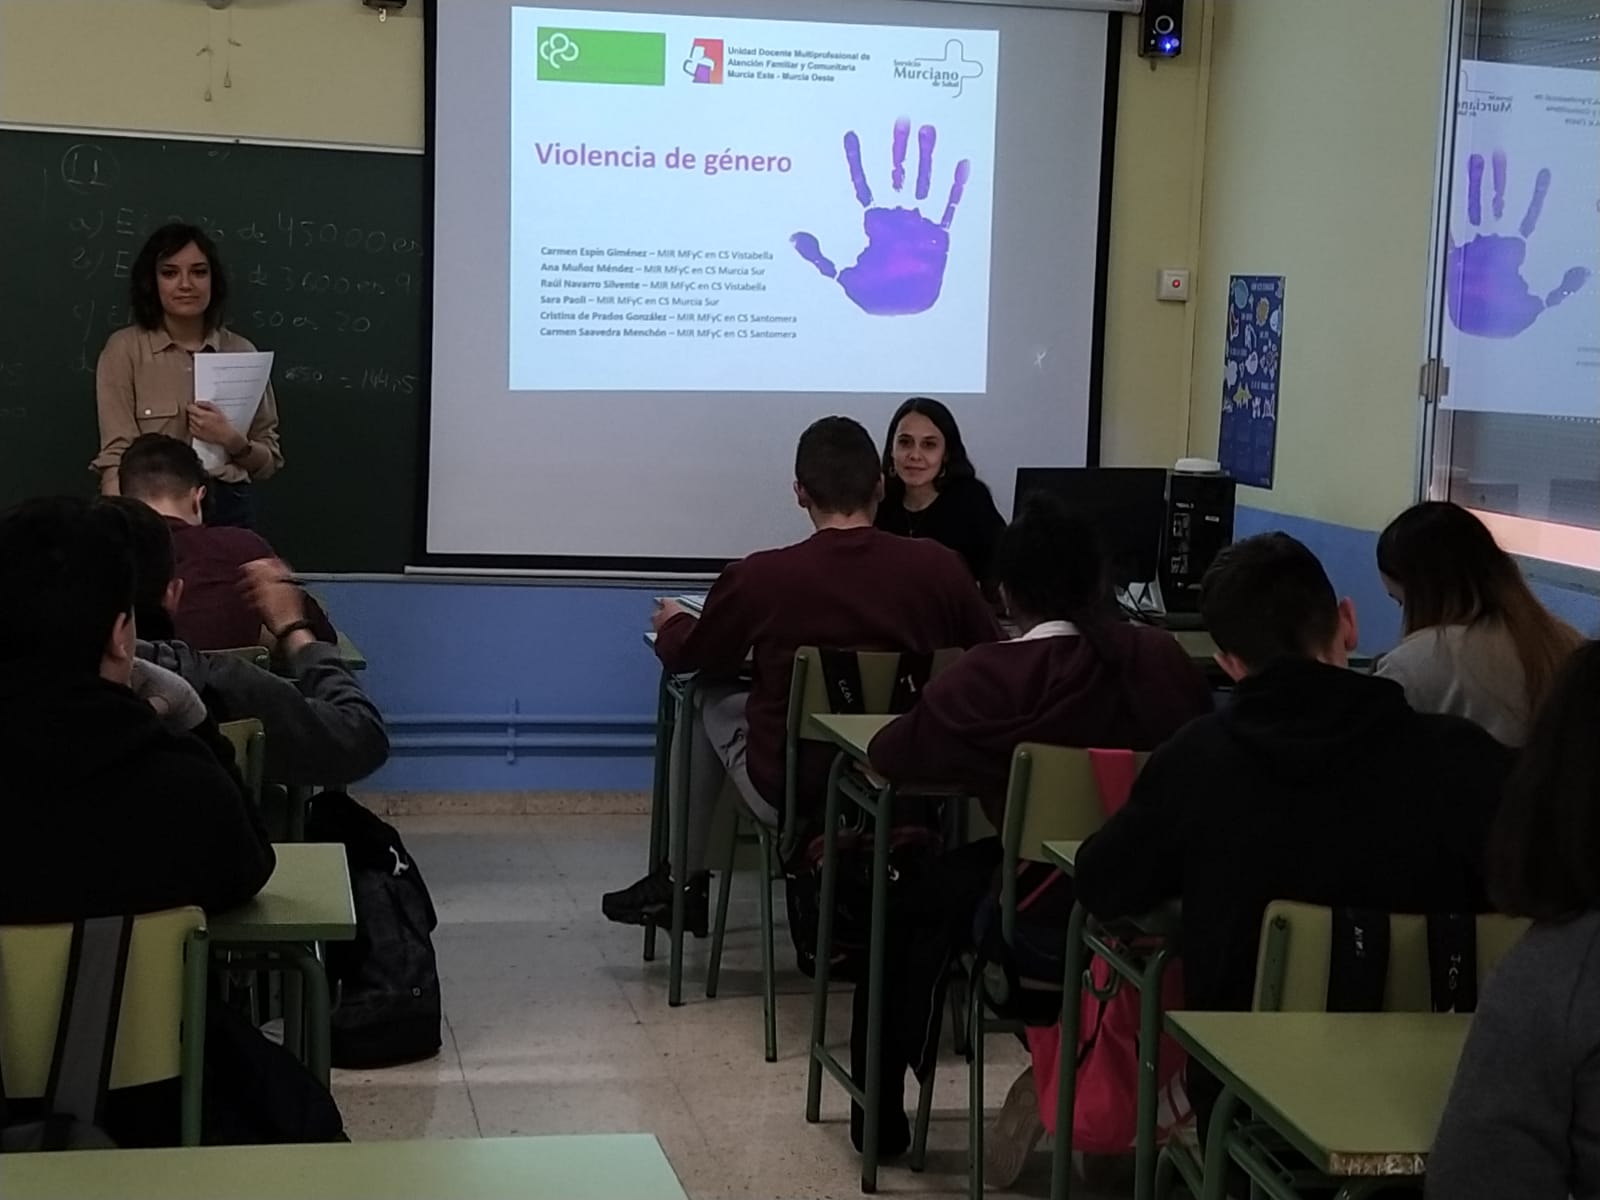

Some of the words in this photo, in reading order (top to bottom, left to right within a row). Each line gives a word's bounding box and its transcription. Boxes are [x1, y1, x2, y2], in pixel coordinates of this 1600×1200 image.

[727, 46, 757, 56] Unidad
[758, 48, 792, 57] Docente
[793, 50, 859, 60] Multiprofesional
[860, 53, 871, 61] de
[727, 58, 764, 68] Atención
[766, 60, 799, 69] Familiar
[807, 61, 856, 71] Comunitaria
[727, 69, 755, 78] Murcia
[756, 71, 775, 79] Este
[781, 72, 809, 81] Murcia
[811, 73, 835, 82] Oeste
[893, 66, 960, 81] Murciano
[534, 141, 657, 168] Violencia
[664, 146, 697, 170] de
[703, 147, 793, 176] género
[540, 246, 578, 256] Carmen
[606, 248, 648, 258] Giménez
[657, 249, 676, 258] MIR
[677, 249, 703, 260] MFyC
[718, 250, 730, 260] CS
[731, 251, 774, 260] Vistabella
[540, 263, 560, 272] Ana
[561, 263, 594, 272] Muñoz
[596, 264, 634, 273] Méndez
[643, 265, 662, 274] MIR
[664, 265, 690, 276] MFyC
[705, 266, 717, 275] CS
[718, 266, 749, 276] Murcia
[751, 267, 766, 276] Sur
[540, 279, 562, 288] Raúl
[563, 280, 602, 289] Navarro
[603, 280, 640, 289] Silvente
[650, 281, 668, 290] MIR
[670, 281, 696, 292] MFyC
[711, 282, 723, 291] CS
[724, 282, 767, 292] Vistabella
[540, 295, 561, 304] Sara
[596, 296, 615, 305] MIR
[617, 296, 643, 307] MFyC
[658, 297, 670, 306] CS
[672, 297, 703, 306] Murcia
[705, 298, 720, 306] Sur
[540, 311, 576, 321] Cristina
[577, 311, 590, 321] de
[591, 312, 624, 321] Prados
[625, 312, 667, 321] González
[676, 313, 695, 322] MIR
[696, 313, 722, 324] MFyC
[737, 314, 749, 323] CS
[750, 314, 798, 324] Santomera
[539, 327, 577, 337] Carmen
[578, 328, 621, 337] Saavedra
[622, 328, 667, 337] Menchón
[676, 329, 695, 338] MIR
[696, 329, 722, 340] MFyC
[737, 329, 749, 339] CS
[750, 330, 798, 340] Santomera
